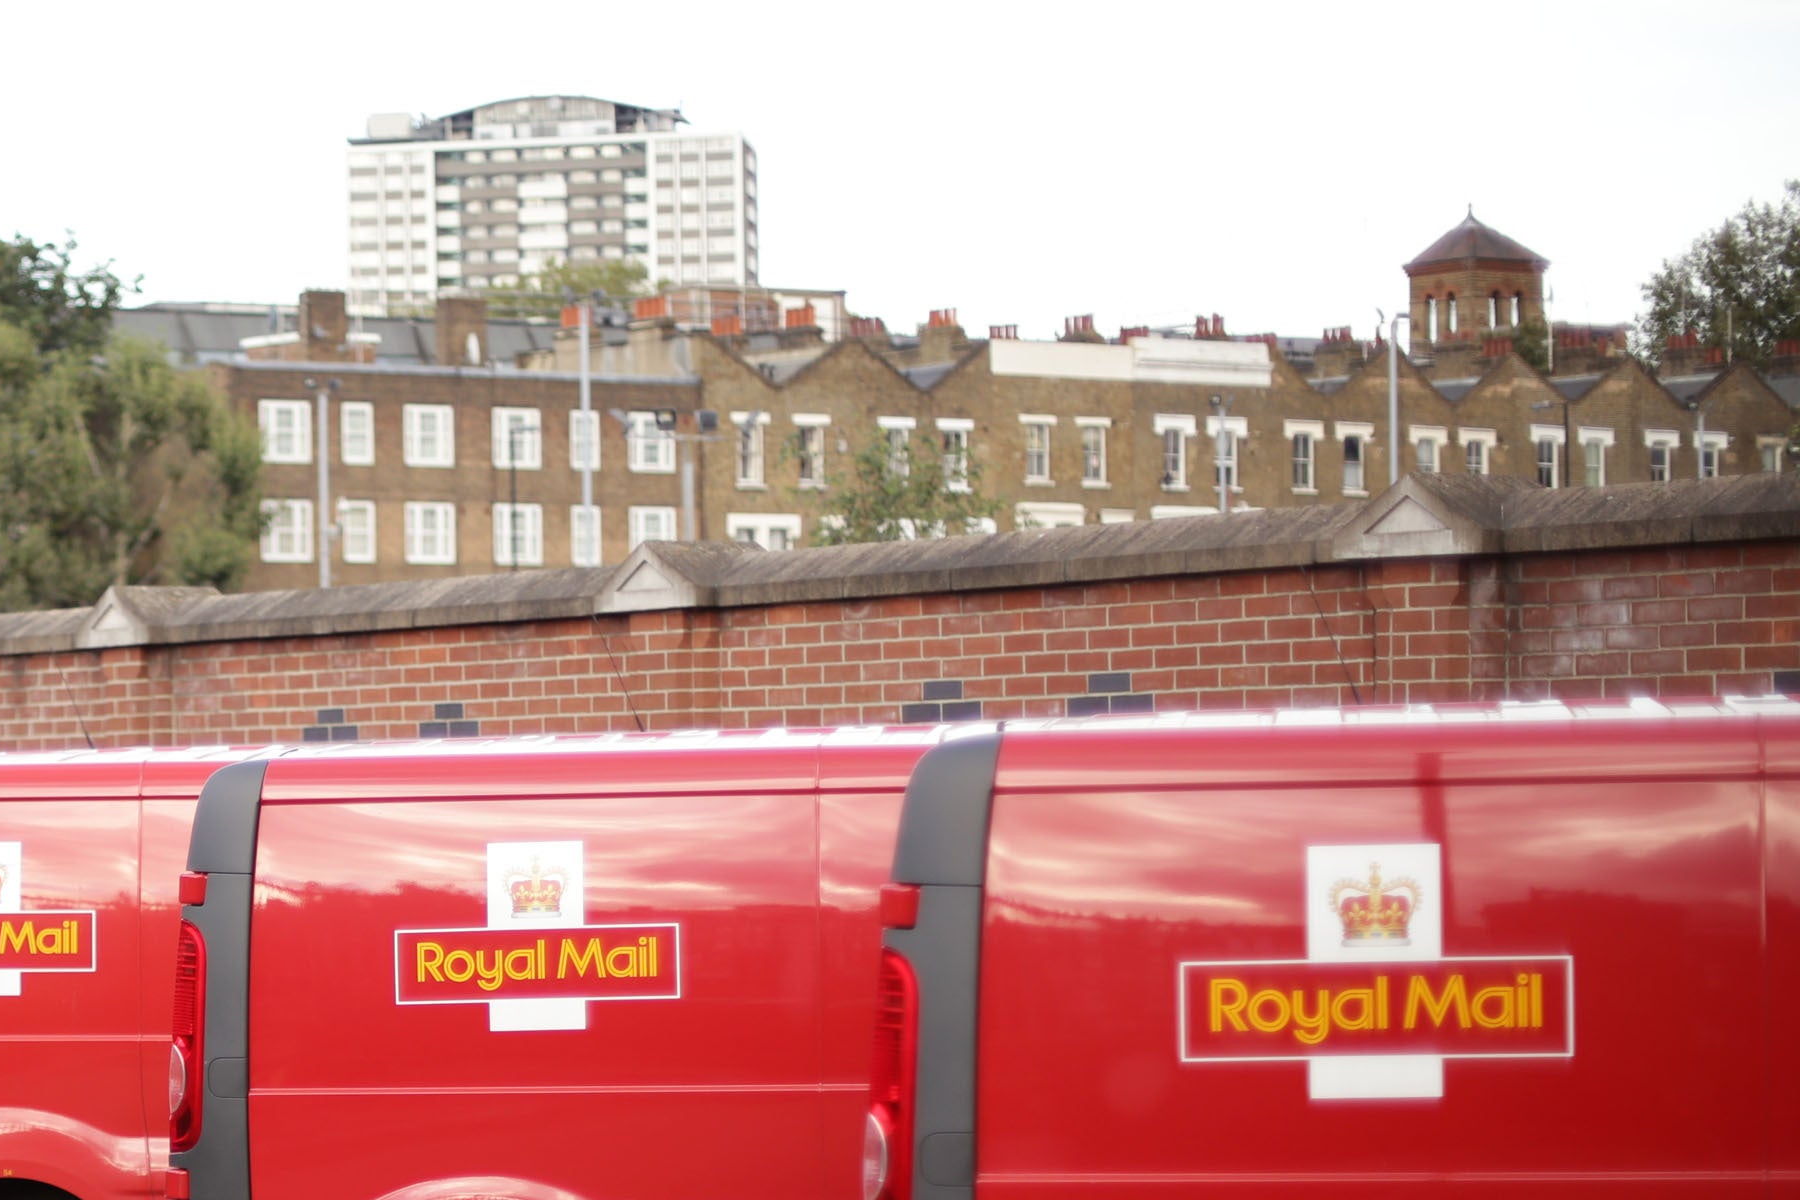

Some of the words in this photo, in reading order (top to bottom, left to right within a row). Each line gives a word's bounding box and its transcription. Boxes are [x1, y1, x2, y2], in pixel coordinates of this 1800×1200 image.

[415, 936, 549, 991] Royal
[554, 935, 660, 979] Mail
[1207, 974, 1388, 1046] Royal
[1402, 971, 1543, 1031] Mail
